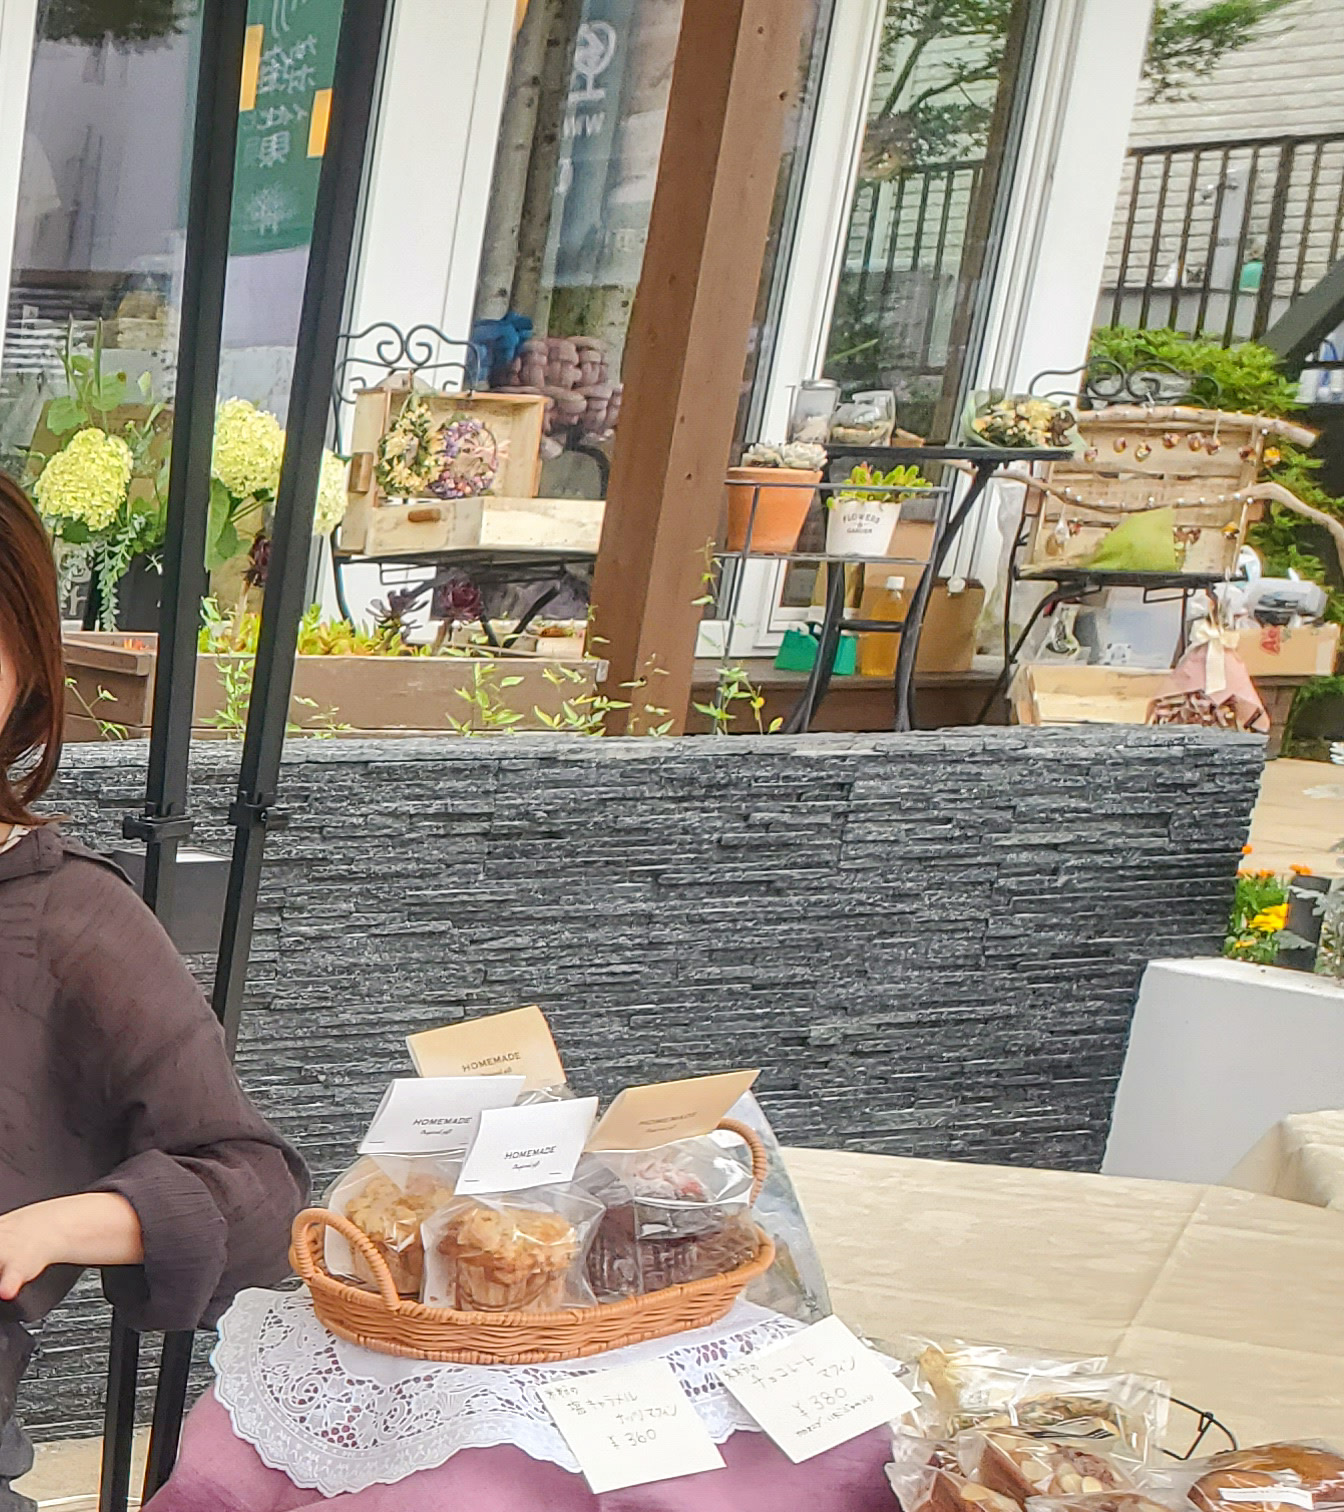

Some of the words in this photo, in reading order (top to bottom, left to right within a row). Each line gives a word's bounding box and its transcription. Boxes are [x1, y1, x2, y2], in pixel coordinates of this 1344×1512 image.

[462, 1052, 521, 1072] HOMEMADE
[412, 1117, 472, 1126] HOMEMADE
[504, 1146, 557, 1160] HOMEMADE
